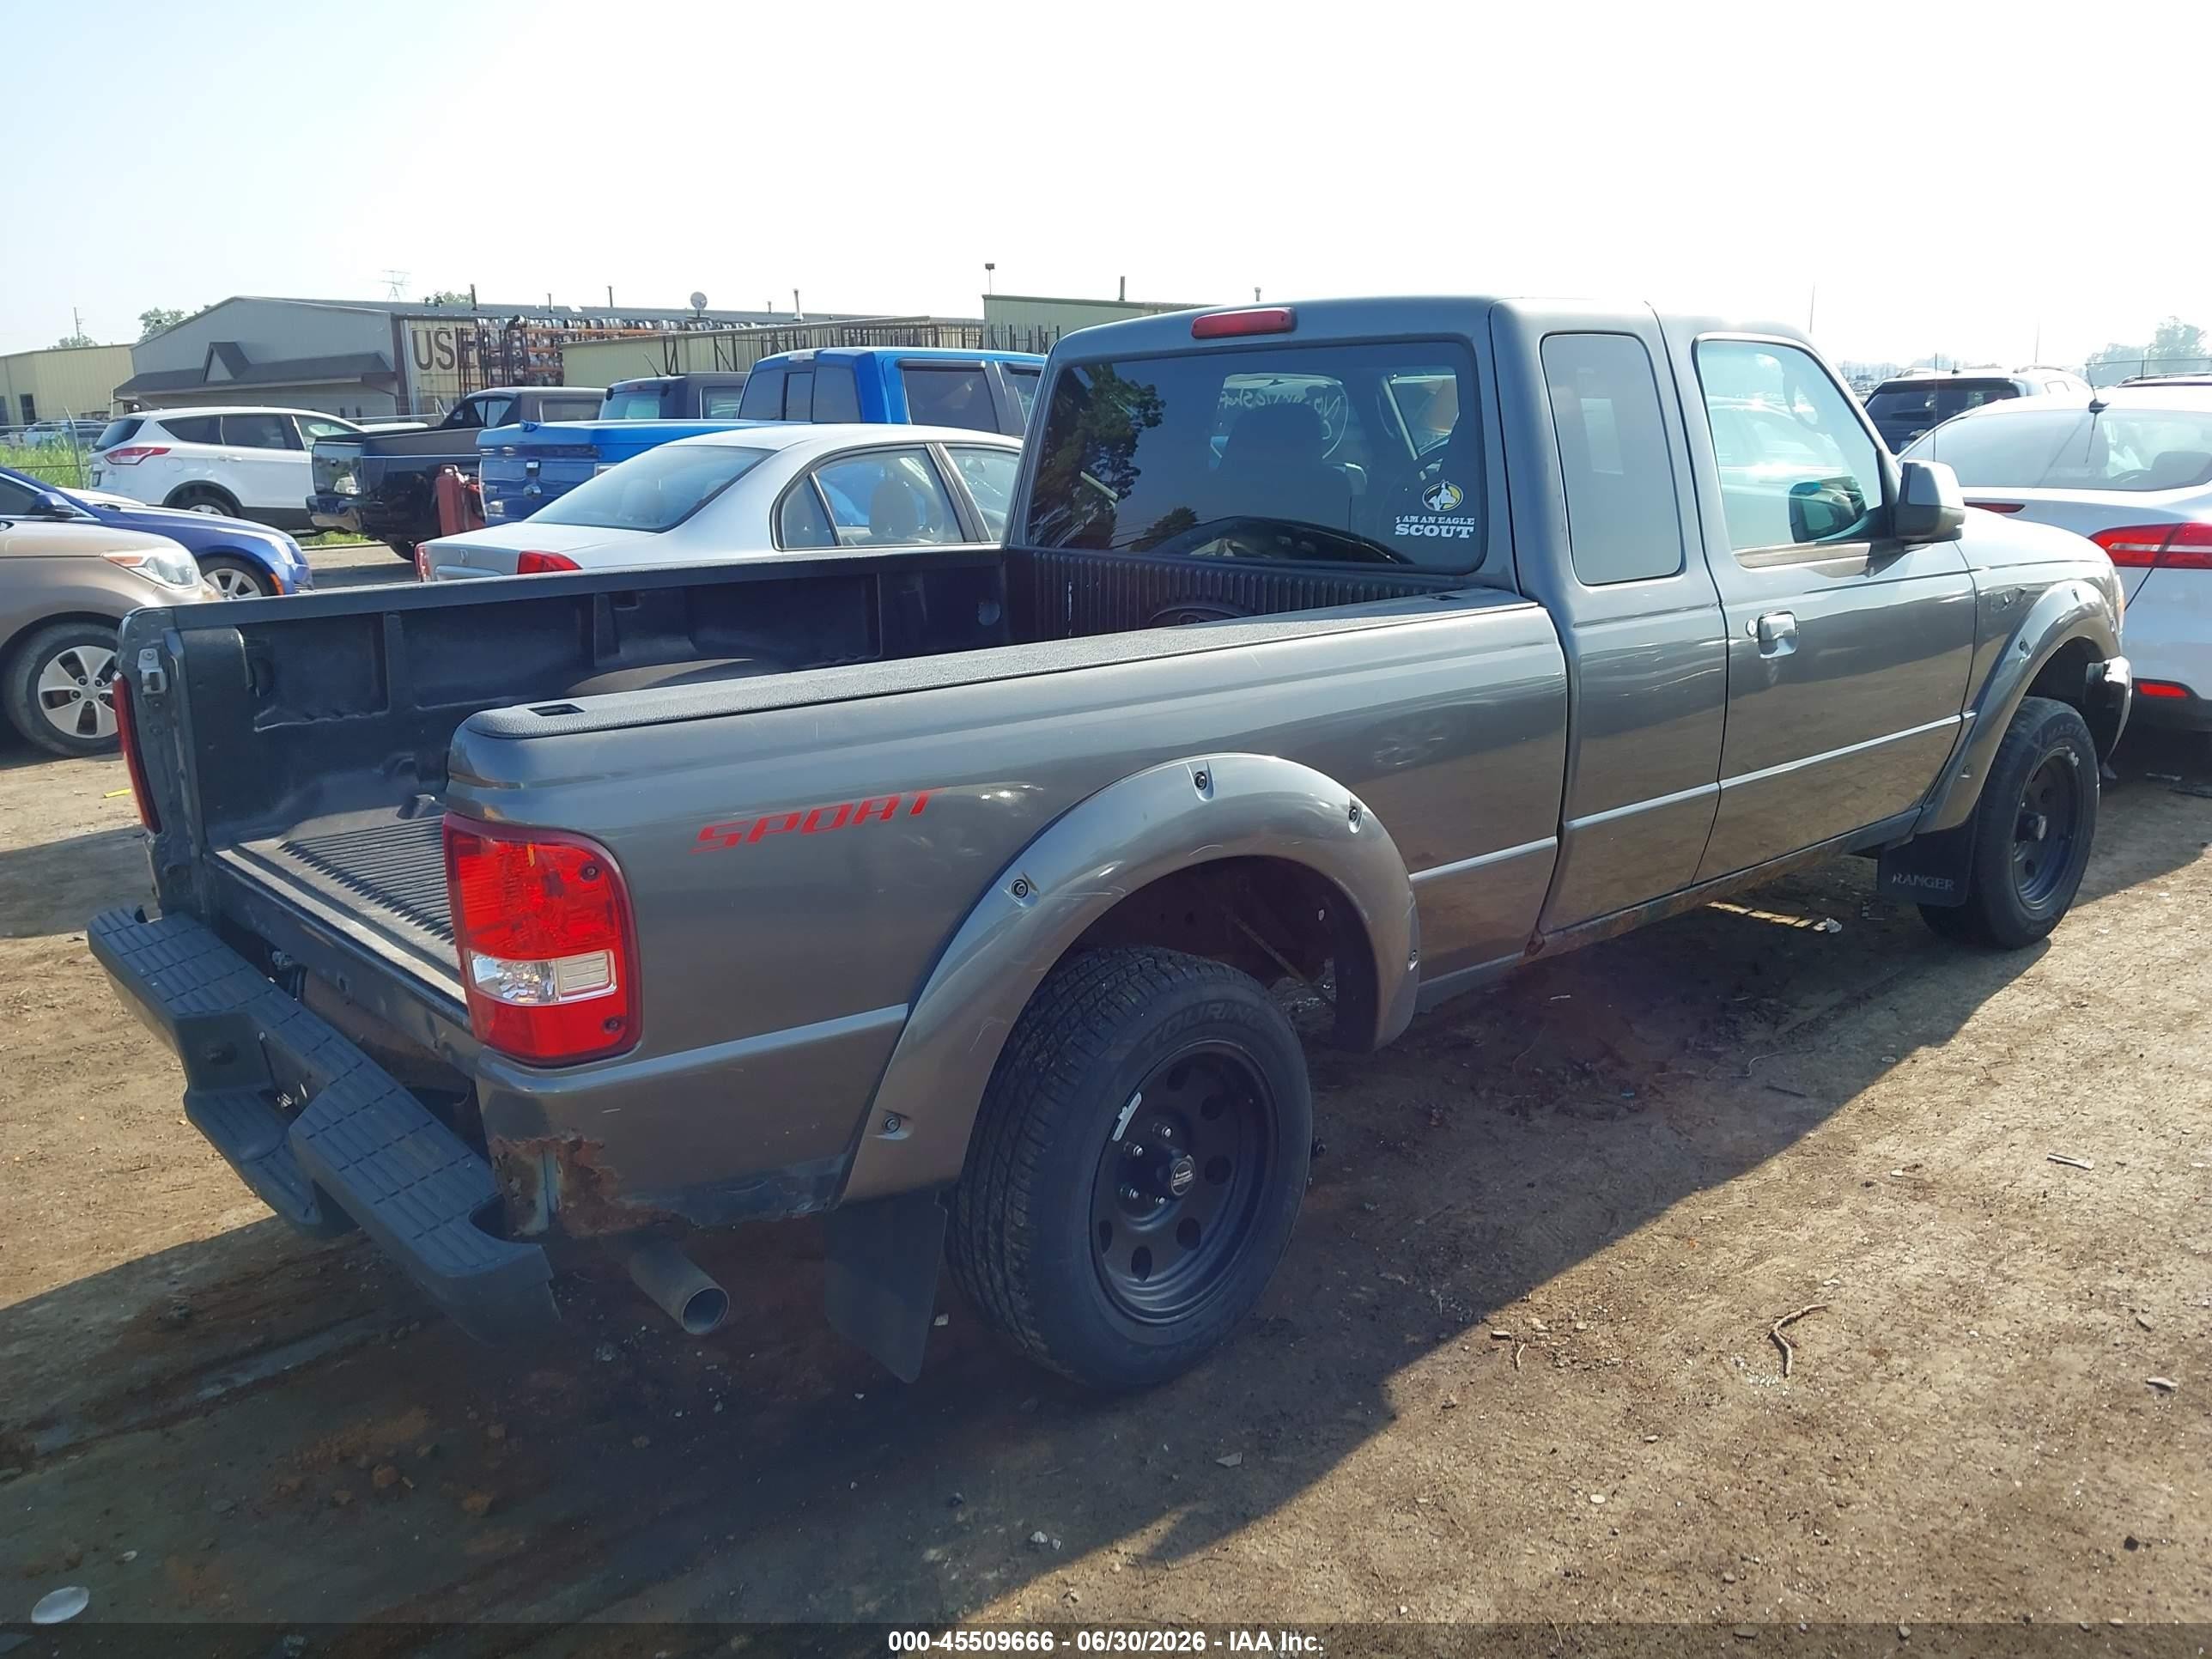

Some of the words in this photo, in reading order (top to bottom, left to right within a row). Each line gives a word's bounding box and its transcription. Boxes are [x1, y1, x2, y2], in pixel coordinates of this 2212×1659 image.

[1419, 515, 1437, 524] AN
[1437, 516, 1475, 526] EAGLE
[1395, 524, 1474, 538] SCOUT
[690, 787, 946, 854] SPORT
[1891, 872, 1955, 891] RANGER
